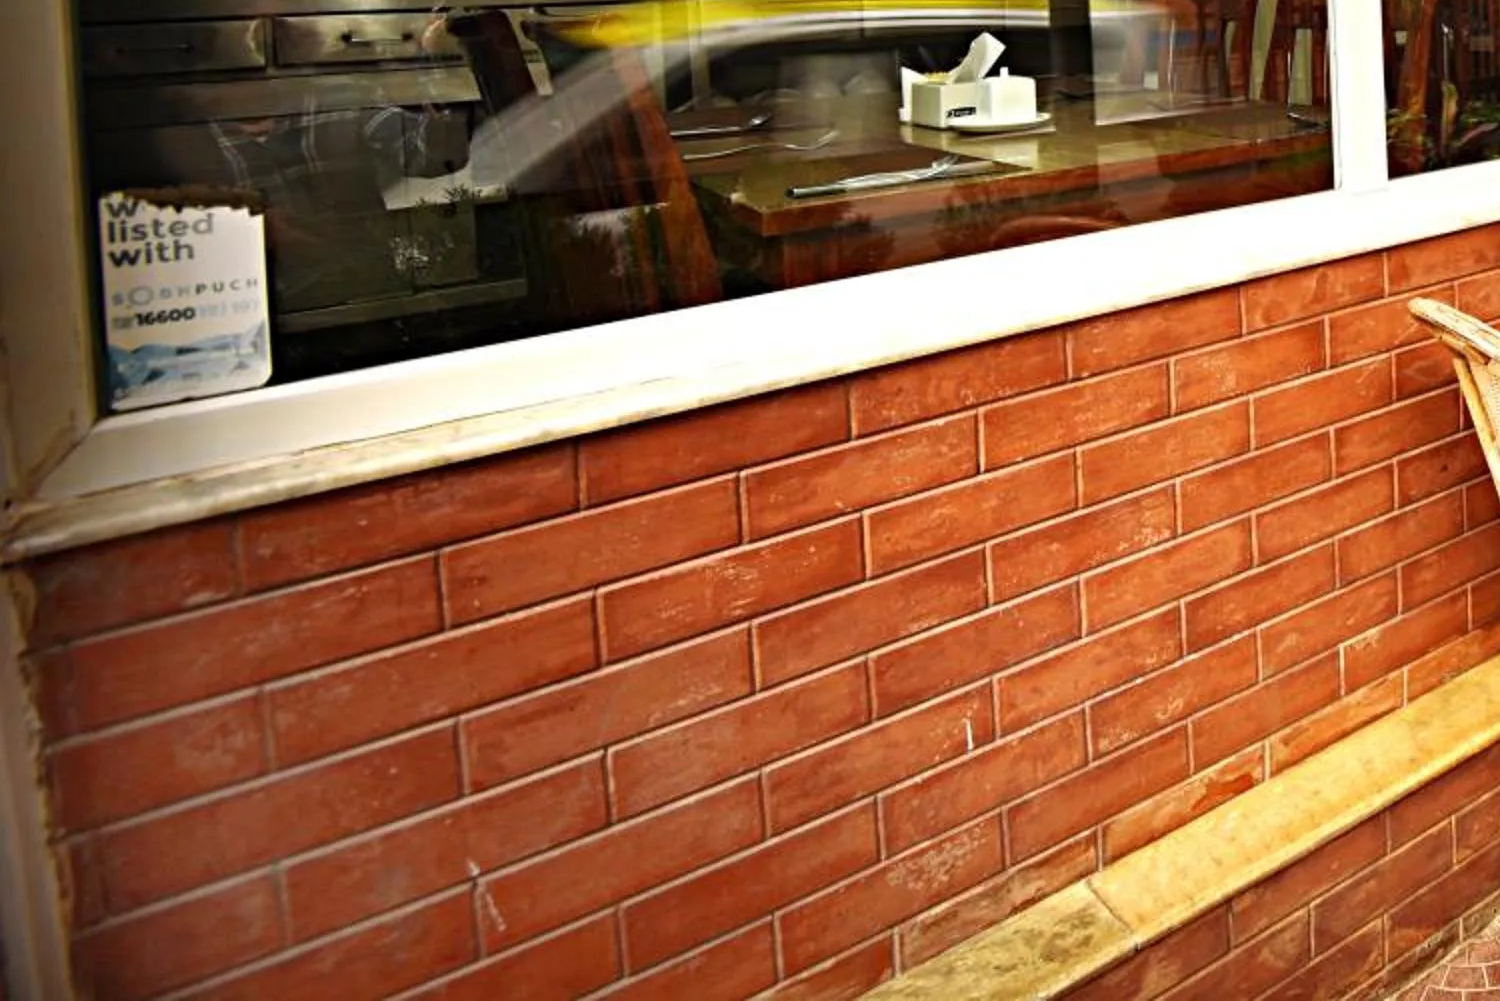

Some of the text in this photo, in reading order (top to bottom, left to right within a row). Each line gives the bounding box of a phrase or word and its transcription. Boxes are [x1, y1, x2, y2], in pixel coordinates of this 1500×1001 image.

[107, 213, 215, 245] listed
[109, 240, 195, 269] with
[134, 306, 196, 328] 16600
